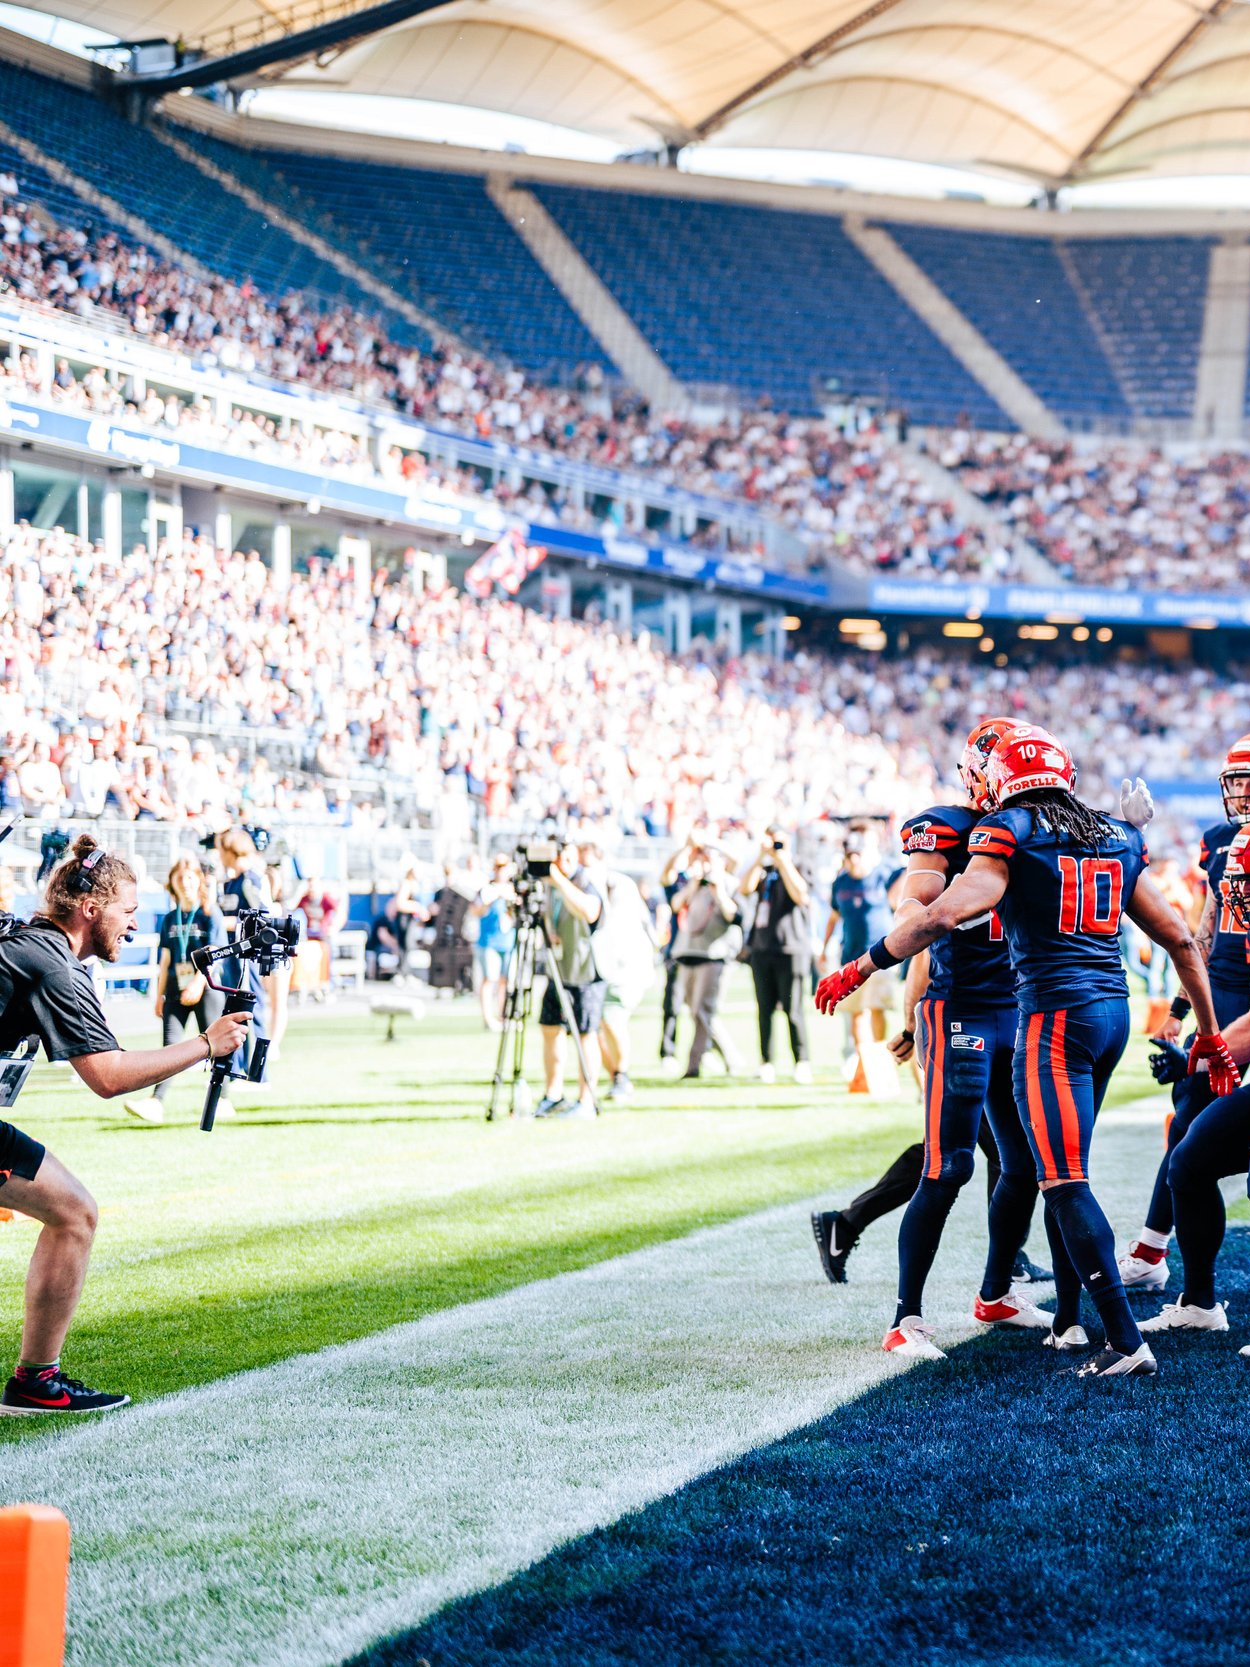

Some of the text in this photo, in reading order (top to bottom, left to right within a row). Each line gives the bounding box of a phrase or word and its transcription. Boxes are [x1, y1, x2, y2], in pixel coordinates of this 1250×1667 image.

[1017, 744, 1037, 759] 10
[1007, 777, 1058, 794] FORELLE
[1058, 855, 1124, 936] 10
[1218, 880, 1249, 934] 1
[211, 947, 234, 960] RONIN
